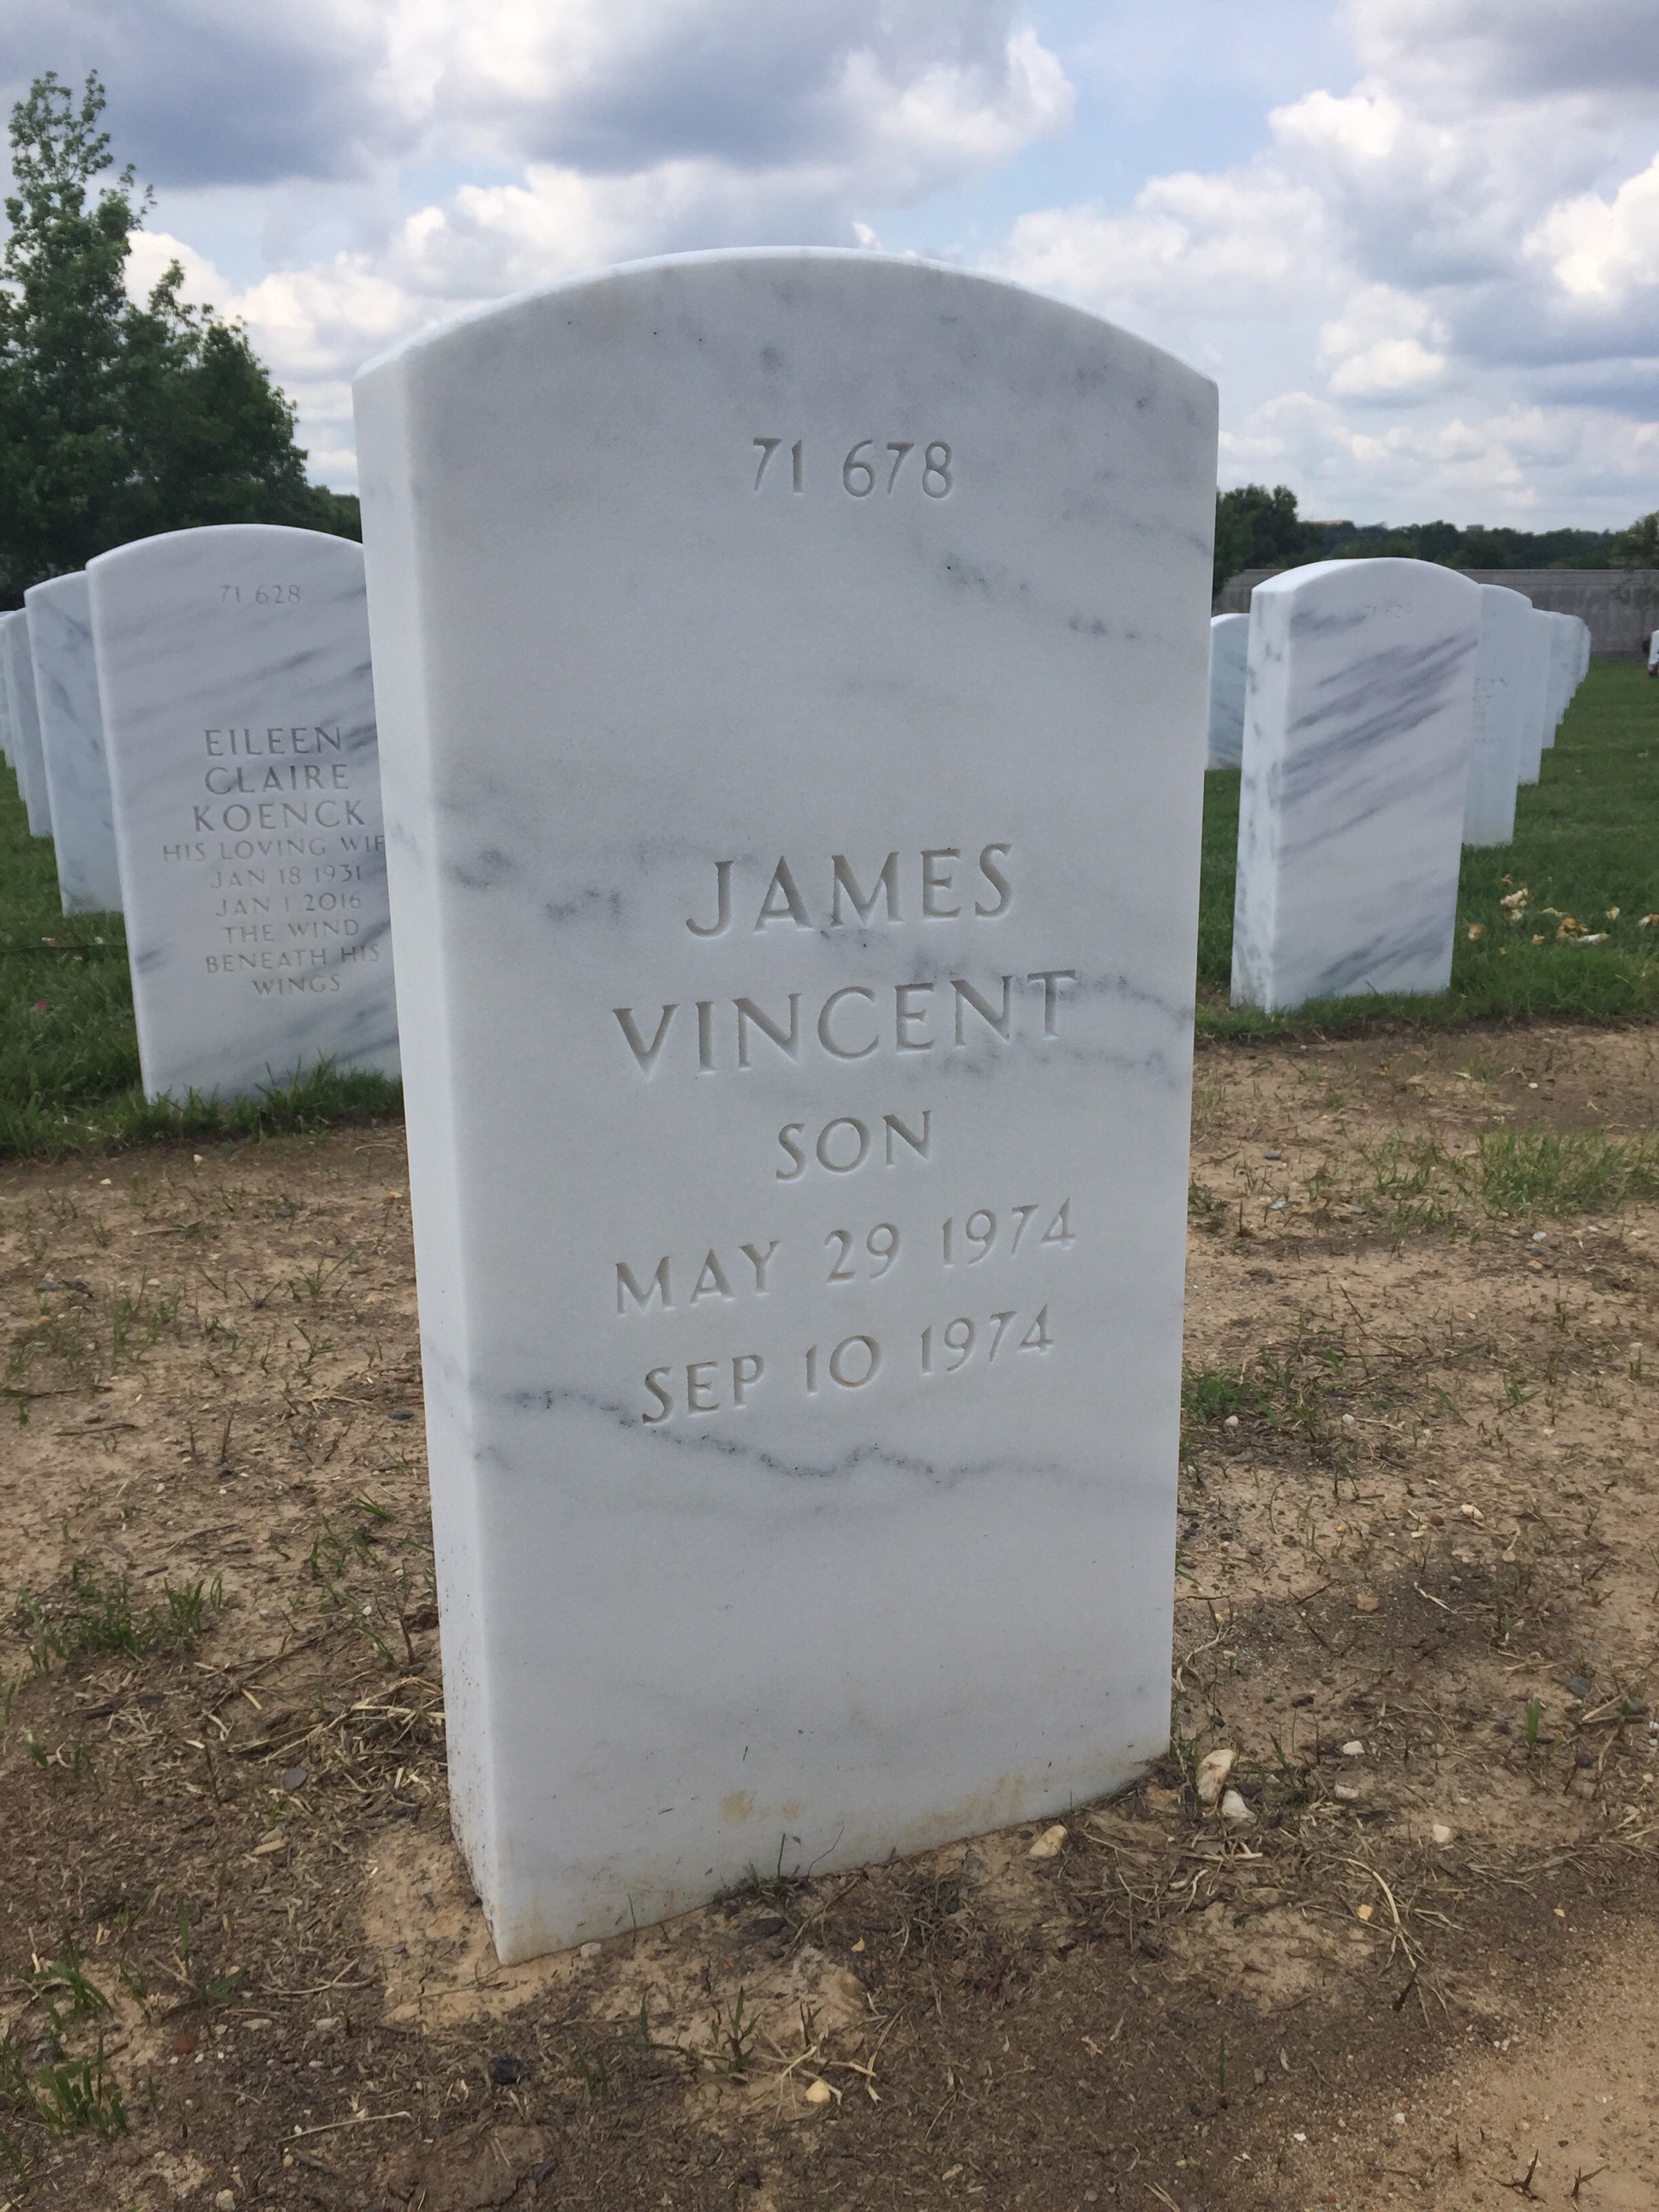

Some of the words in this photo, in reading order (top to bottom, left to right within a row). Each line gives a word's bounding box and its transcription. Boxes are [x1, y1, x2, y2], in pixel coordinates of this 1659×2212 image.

[752, 436, 803, 494] 71
[842, 438, 954, 500] 678
[220, 584, 241, 603] 71
[255, 584, 301, 604] 628
[205, 727, 341, 757] EILEEN
[205, 764, 350, 795] CLAIRE
[192, 800, 365, 832] KOENCK
[163, 842, 207, 862] HIS
[219, 837, 326, 860] LOVING
[340, 835, 385, 854] WIF
[209, 869, 266, 890] JAN
[278, 866, 302, 885] 18
[314, 864, 362, 884] 1931
[686, 842, 1013, 939] JAMES
[215, 897, 270, 917] JAN
[284, 896, 290, 913] 1
[304, 891, 362, 911] 2016
[224, 925, 274, 944] THE
[288, 919, 359, 939] WIND
[206, 947, 327, 974] BENEATH
[340, 944, 380, 964] HIS
[251, 974, 341, 996] WINGS
[611, 969, 1077, 1083] VINCENT
[776, 1110, 932, 1183] SON
[614, 1240, 781, 1315] MAY
[824, 1221, 901, 1284] 29
[942, 1196, 1076, 1268] 1974
[642, 1353, 766, 1424] SEP
[805, 1334, 883, 1396] 10
[920, 1302, 1055, 1376] 1974
